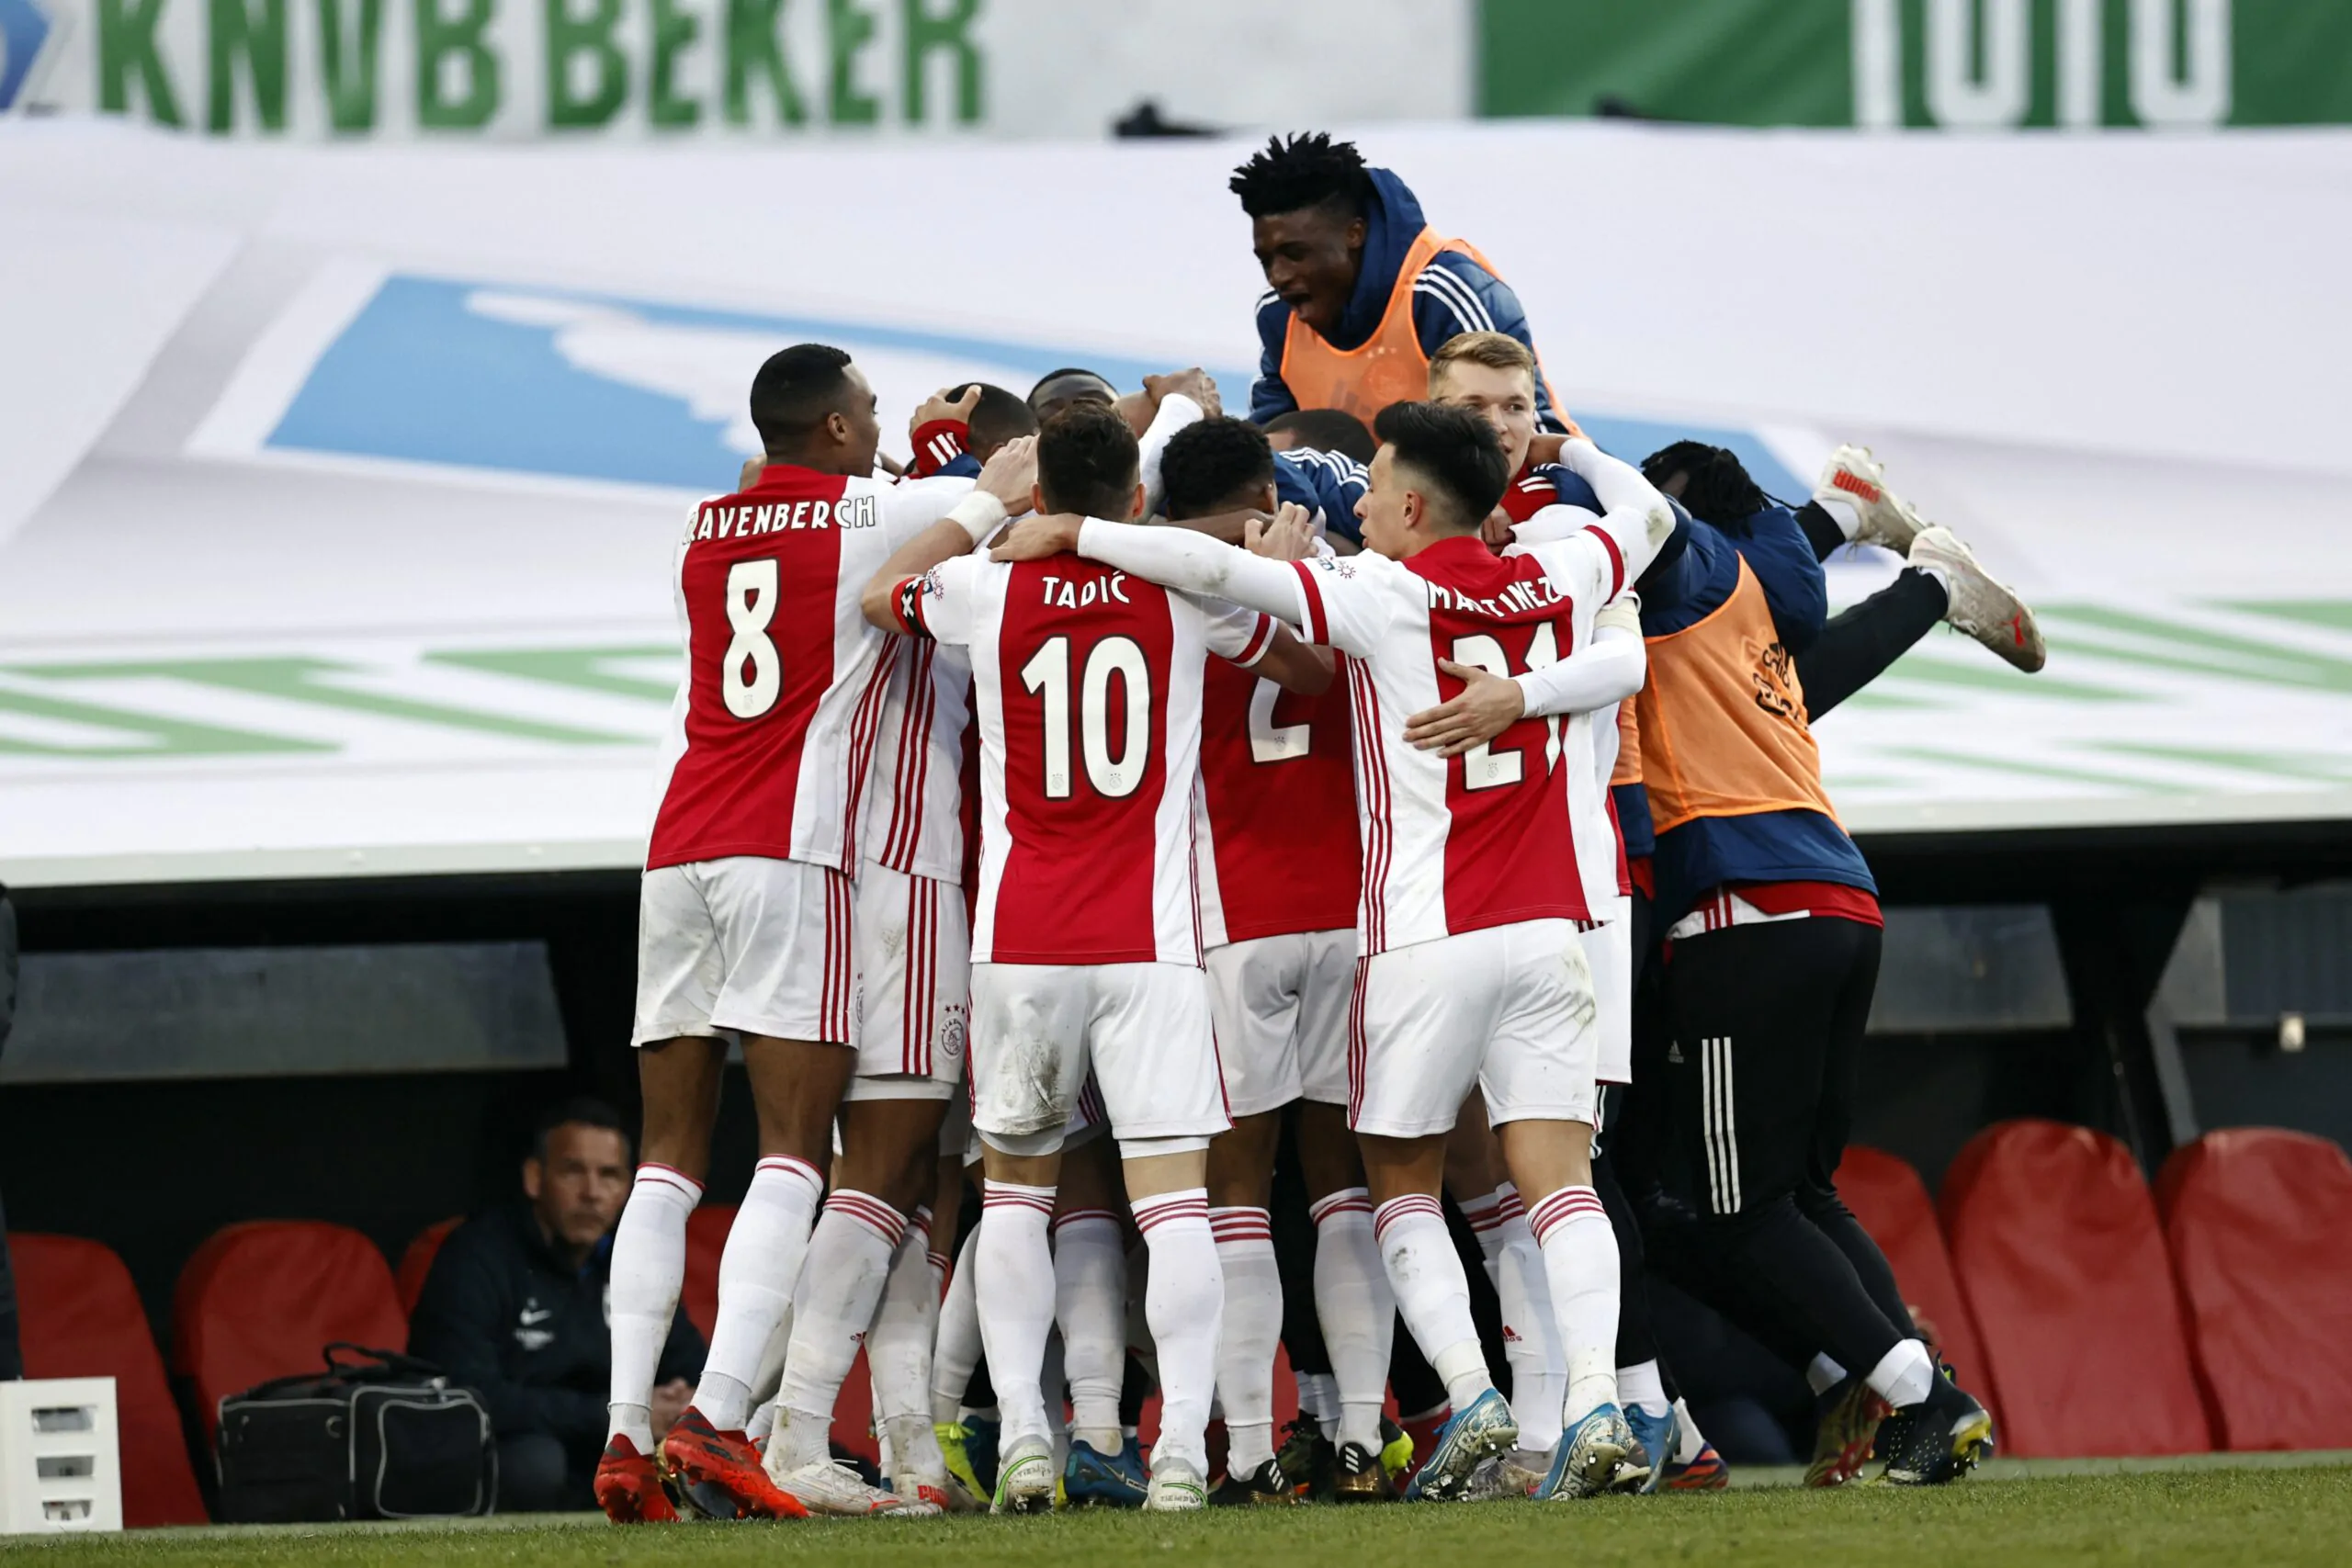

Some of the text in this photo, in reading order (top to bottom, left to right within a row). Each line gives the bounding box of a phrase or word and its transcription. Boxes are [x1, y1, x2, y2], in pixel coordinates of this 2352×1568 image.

[97, 0, 987, 133] KNVB BEKER
[721, 557, 782, 720] 8
[1042, 570, 1130, 609] TADIĆ
[1021, 635, 1151, 800] 10
[1451, 620, 1562, 793] 21
